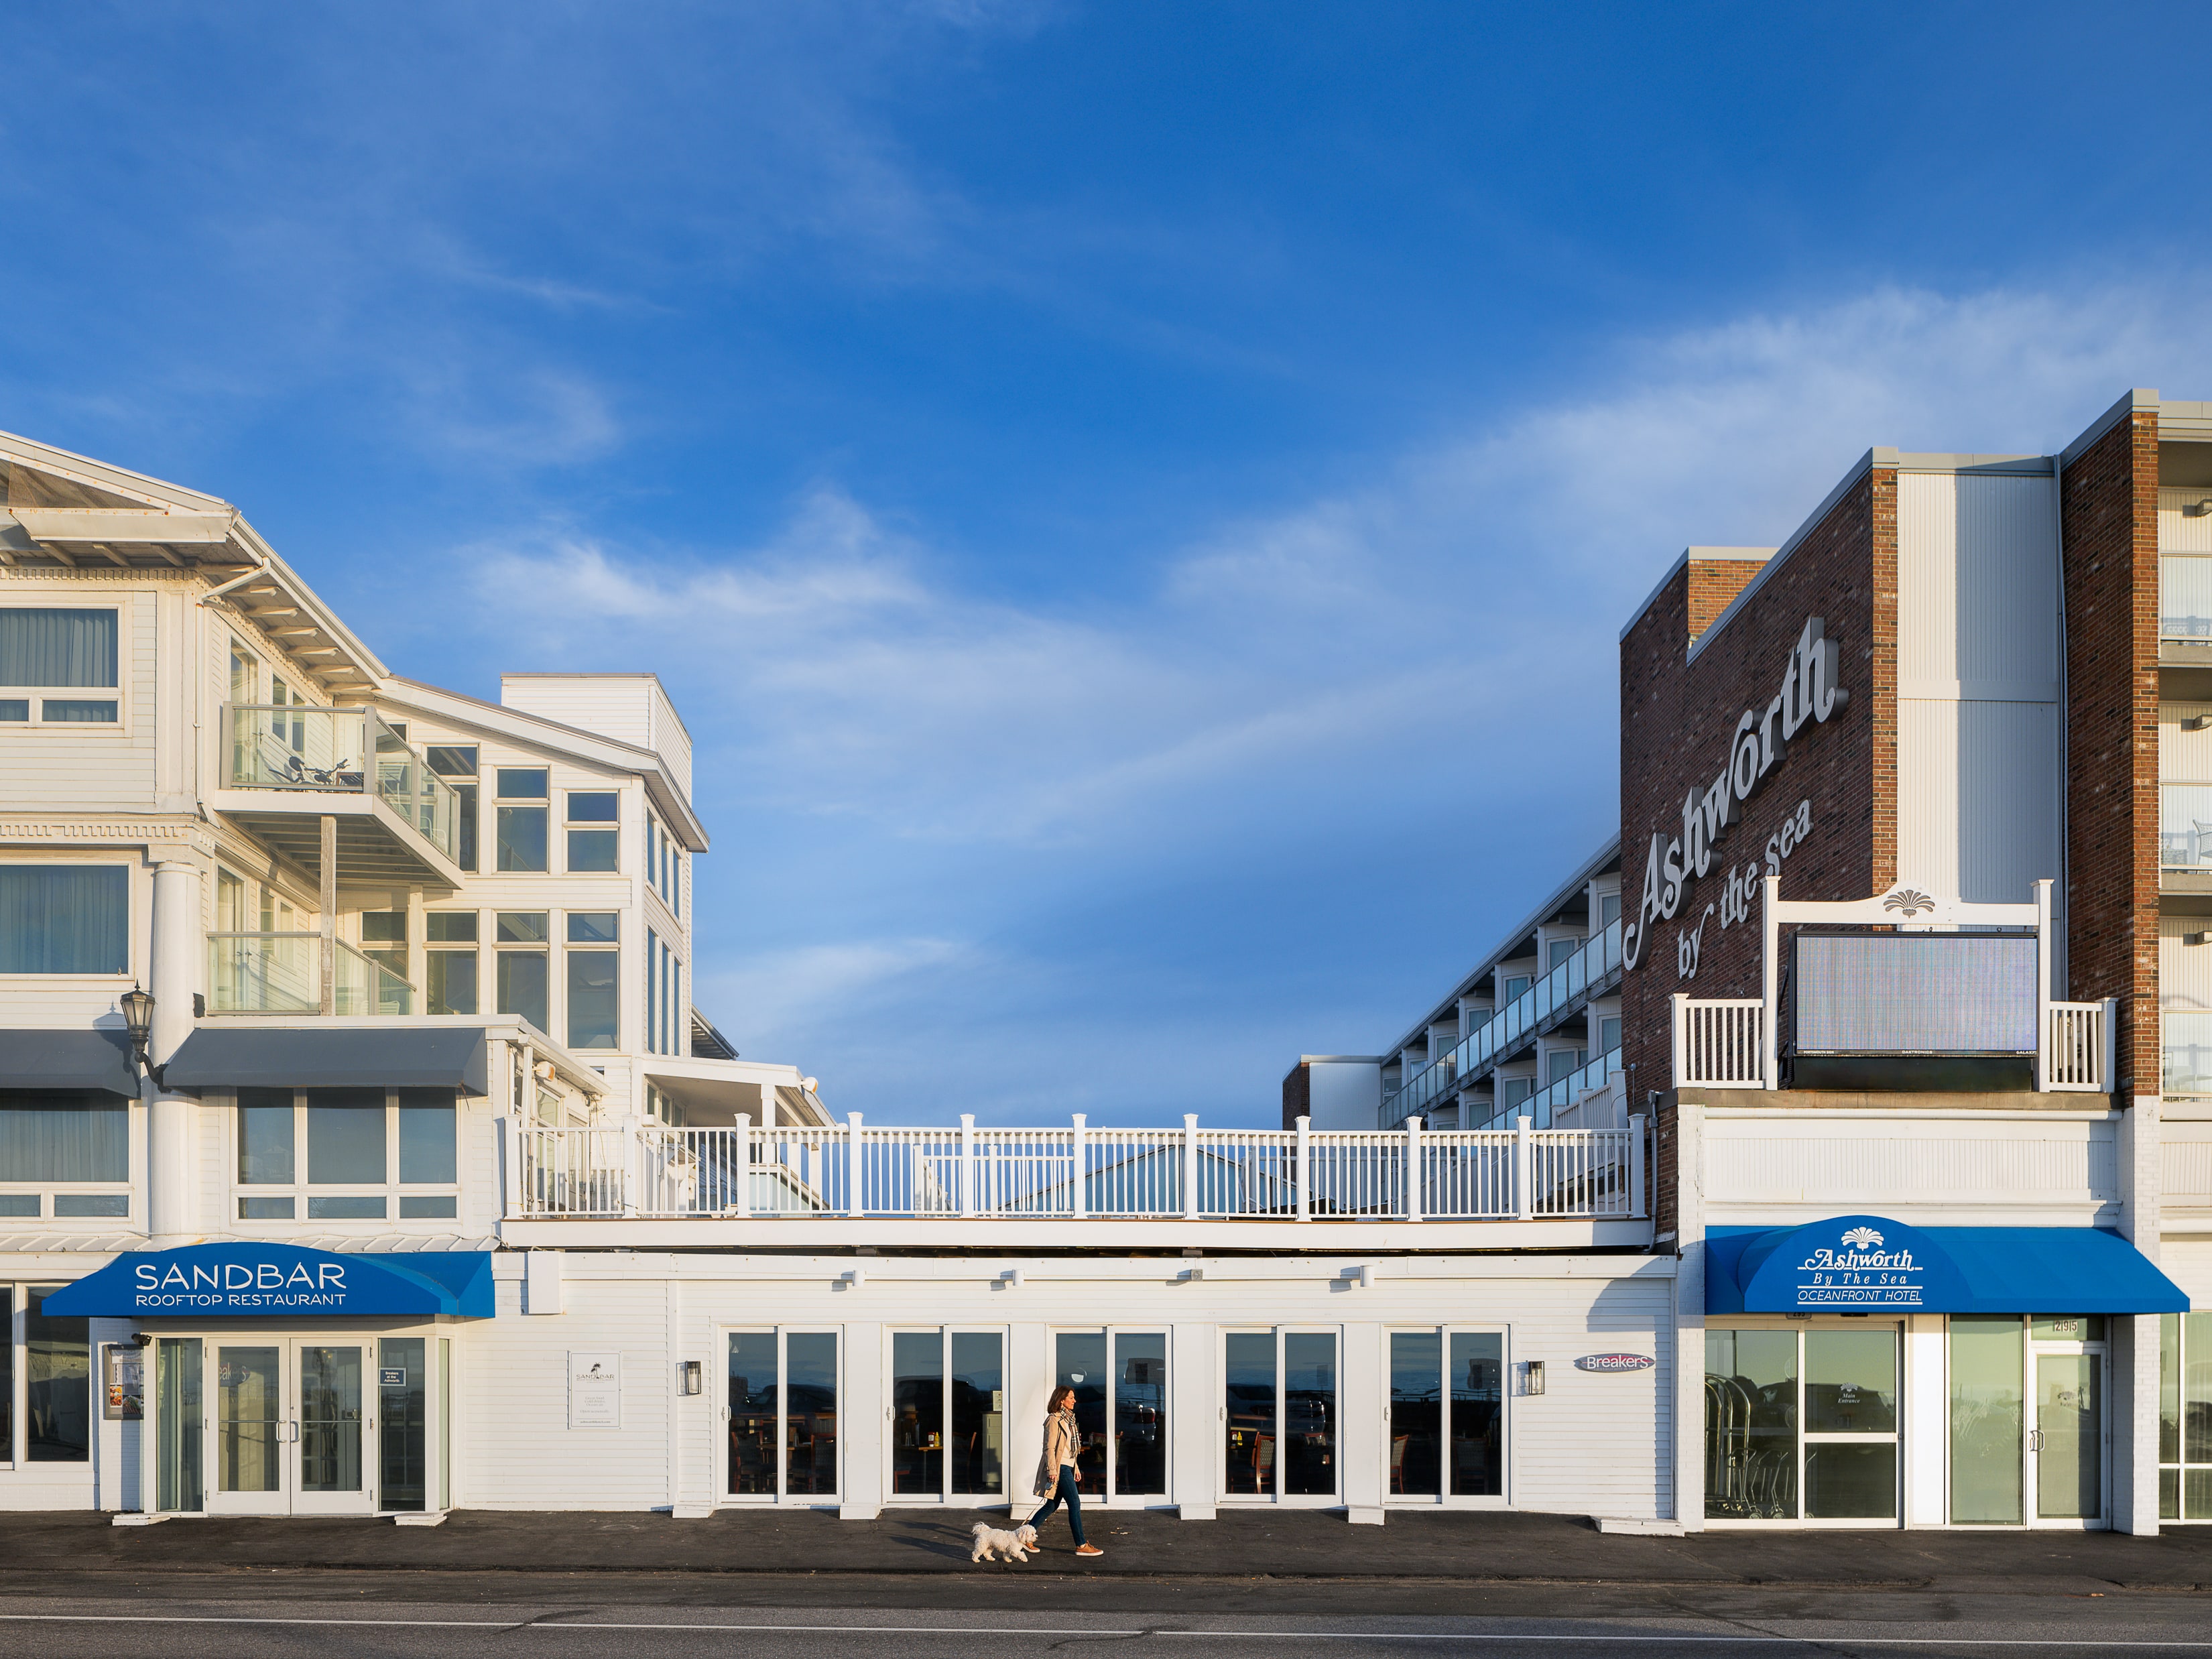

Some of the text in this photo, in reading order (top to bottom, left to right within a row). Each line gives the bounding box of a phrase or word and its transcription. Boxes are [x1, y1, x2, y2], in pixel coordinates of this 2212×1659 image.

[1623, 616, 1839, 971] Ashworth
[1678, 799, 1813, 979] by the sea
[1804, 1248, 1915, 1272] Ashworth
[135, 1262, 347, 1291] SANDBAR
[1812, 1272, 1908, 1286] By The Sea
[136, 1294, 347, 1306] ROOFTOP RESTAURANT
[1798, 1290, 1922, 1301] OCEANFRONT HOTEL
[2055, 1320, 2077, 1331] 295
